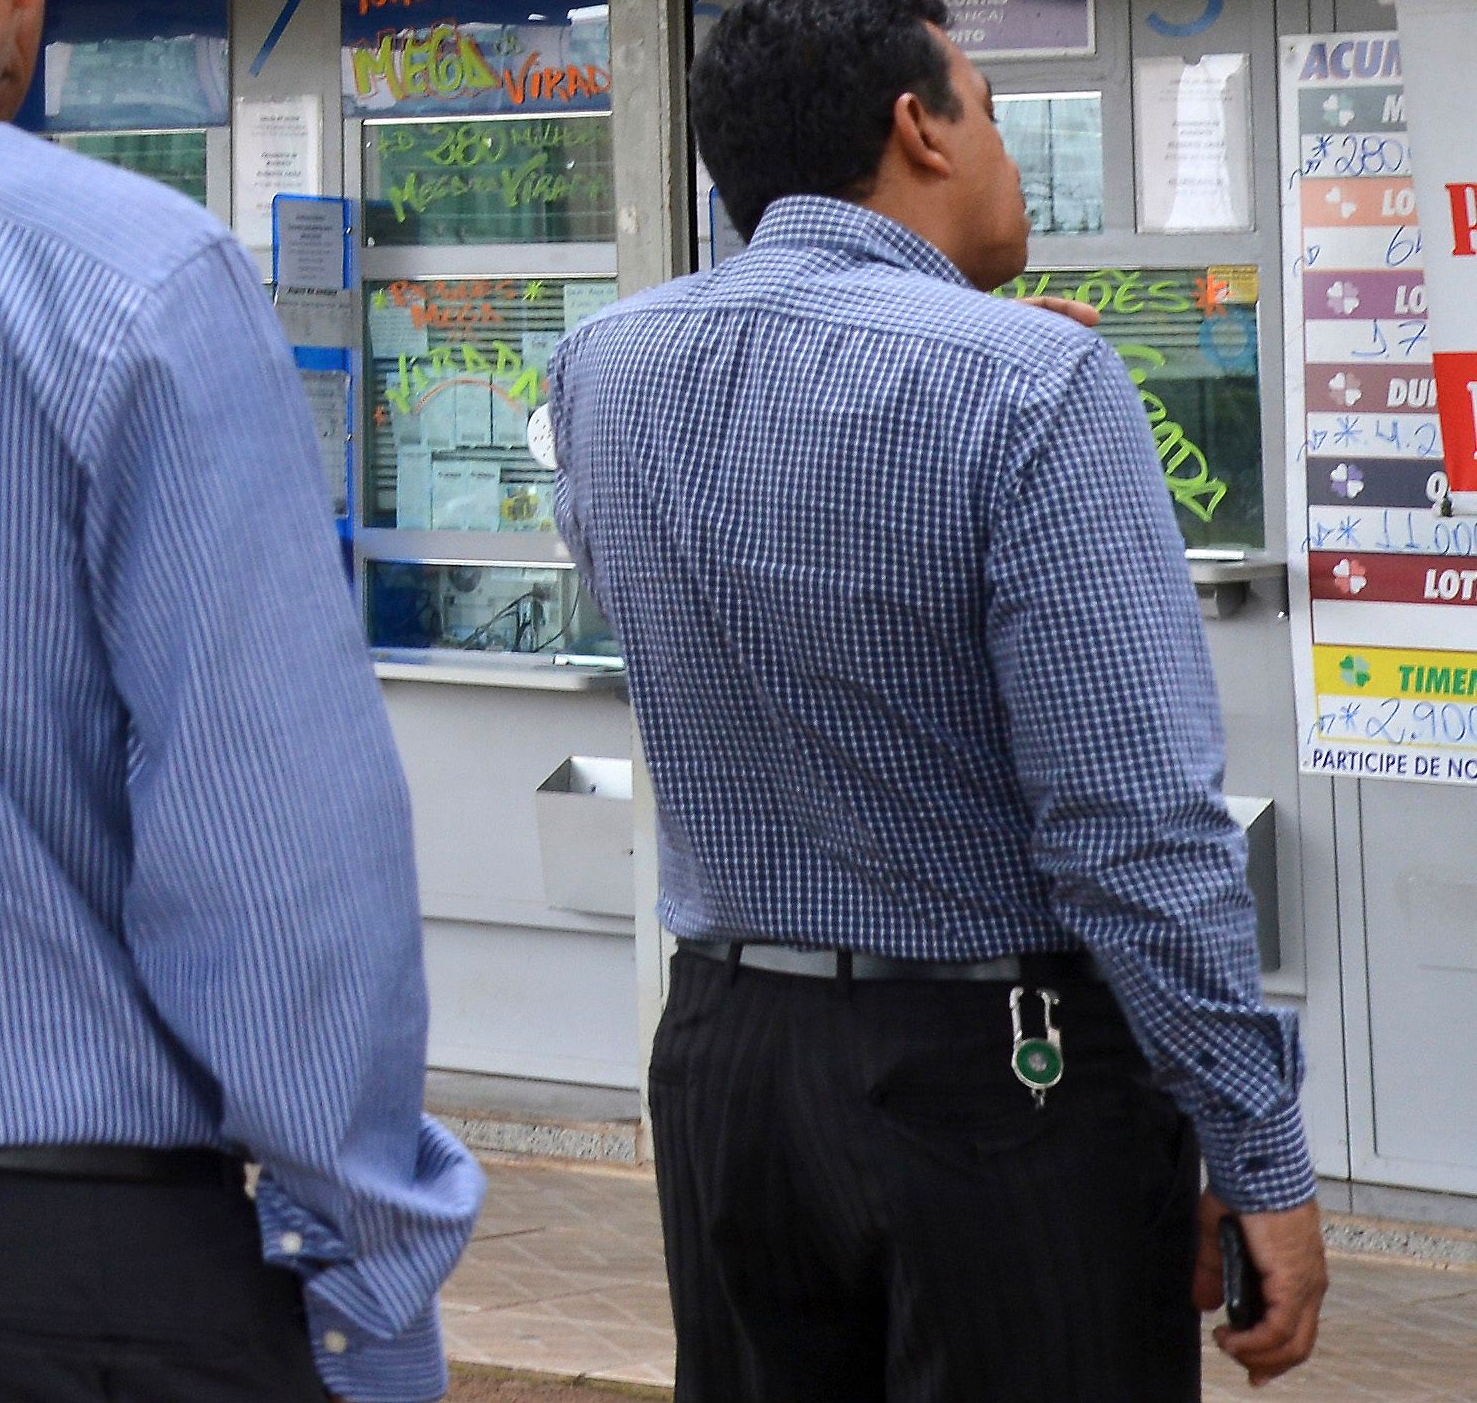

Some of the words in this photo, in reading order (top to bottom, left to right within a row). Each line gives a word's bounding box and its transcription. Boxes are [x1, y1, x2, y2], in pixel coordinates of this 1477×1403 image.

[502, 52, 612, 105] VIRAD
[1312, 748, 1407, 775] PARTICIPE
[1414, 756, 1440, 777] DE
